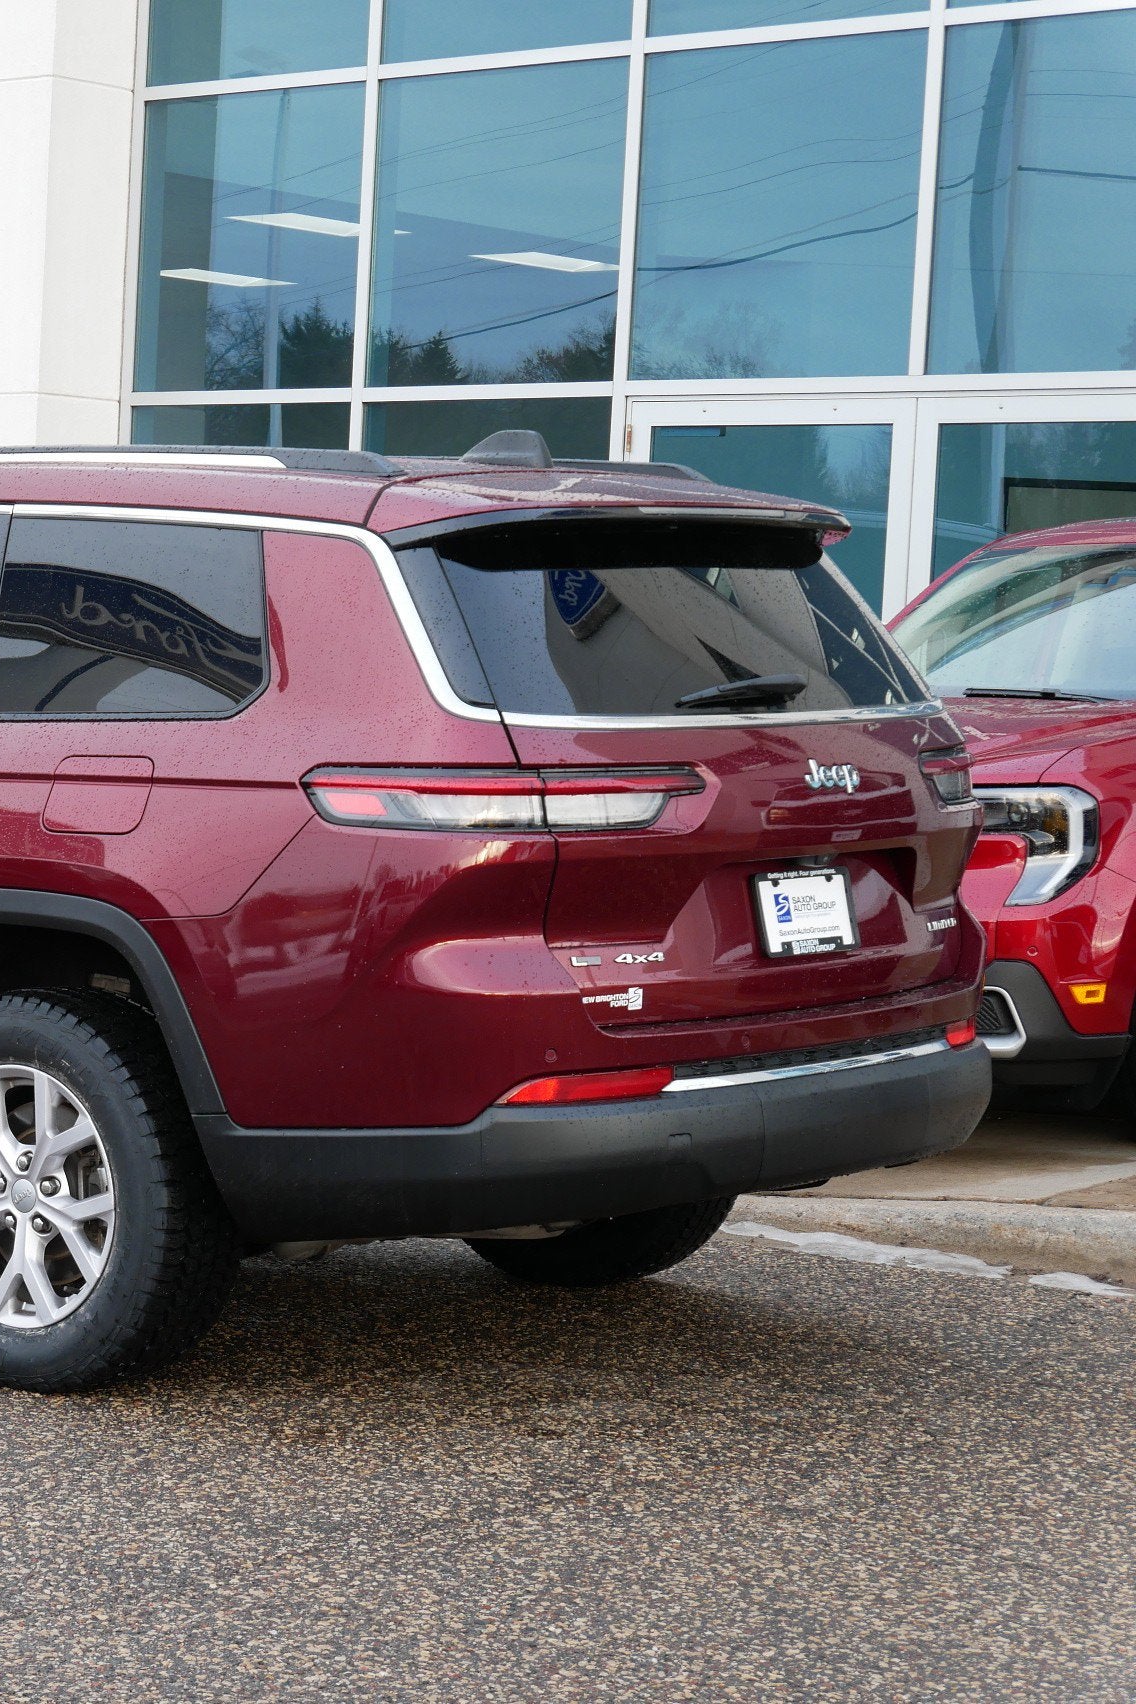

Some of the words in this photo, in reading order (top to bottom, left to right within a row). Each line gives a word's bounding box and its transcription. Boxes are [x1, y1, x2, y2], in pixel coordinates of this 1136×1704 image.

[805, 758, 861, 795] Jeep
[792, 895, 816, 904] SAXON
[794, 903, 812, 912] AUTO
[813, 901, 837, 910] GROUP
[778, 925, 840, 937] SaxonAutoGroup.com
[614, 951, 665, 964] 4x4
[596, 993, 629, 1002] BRIGHTON
[610, 1000, 628, 1008] FORD
